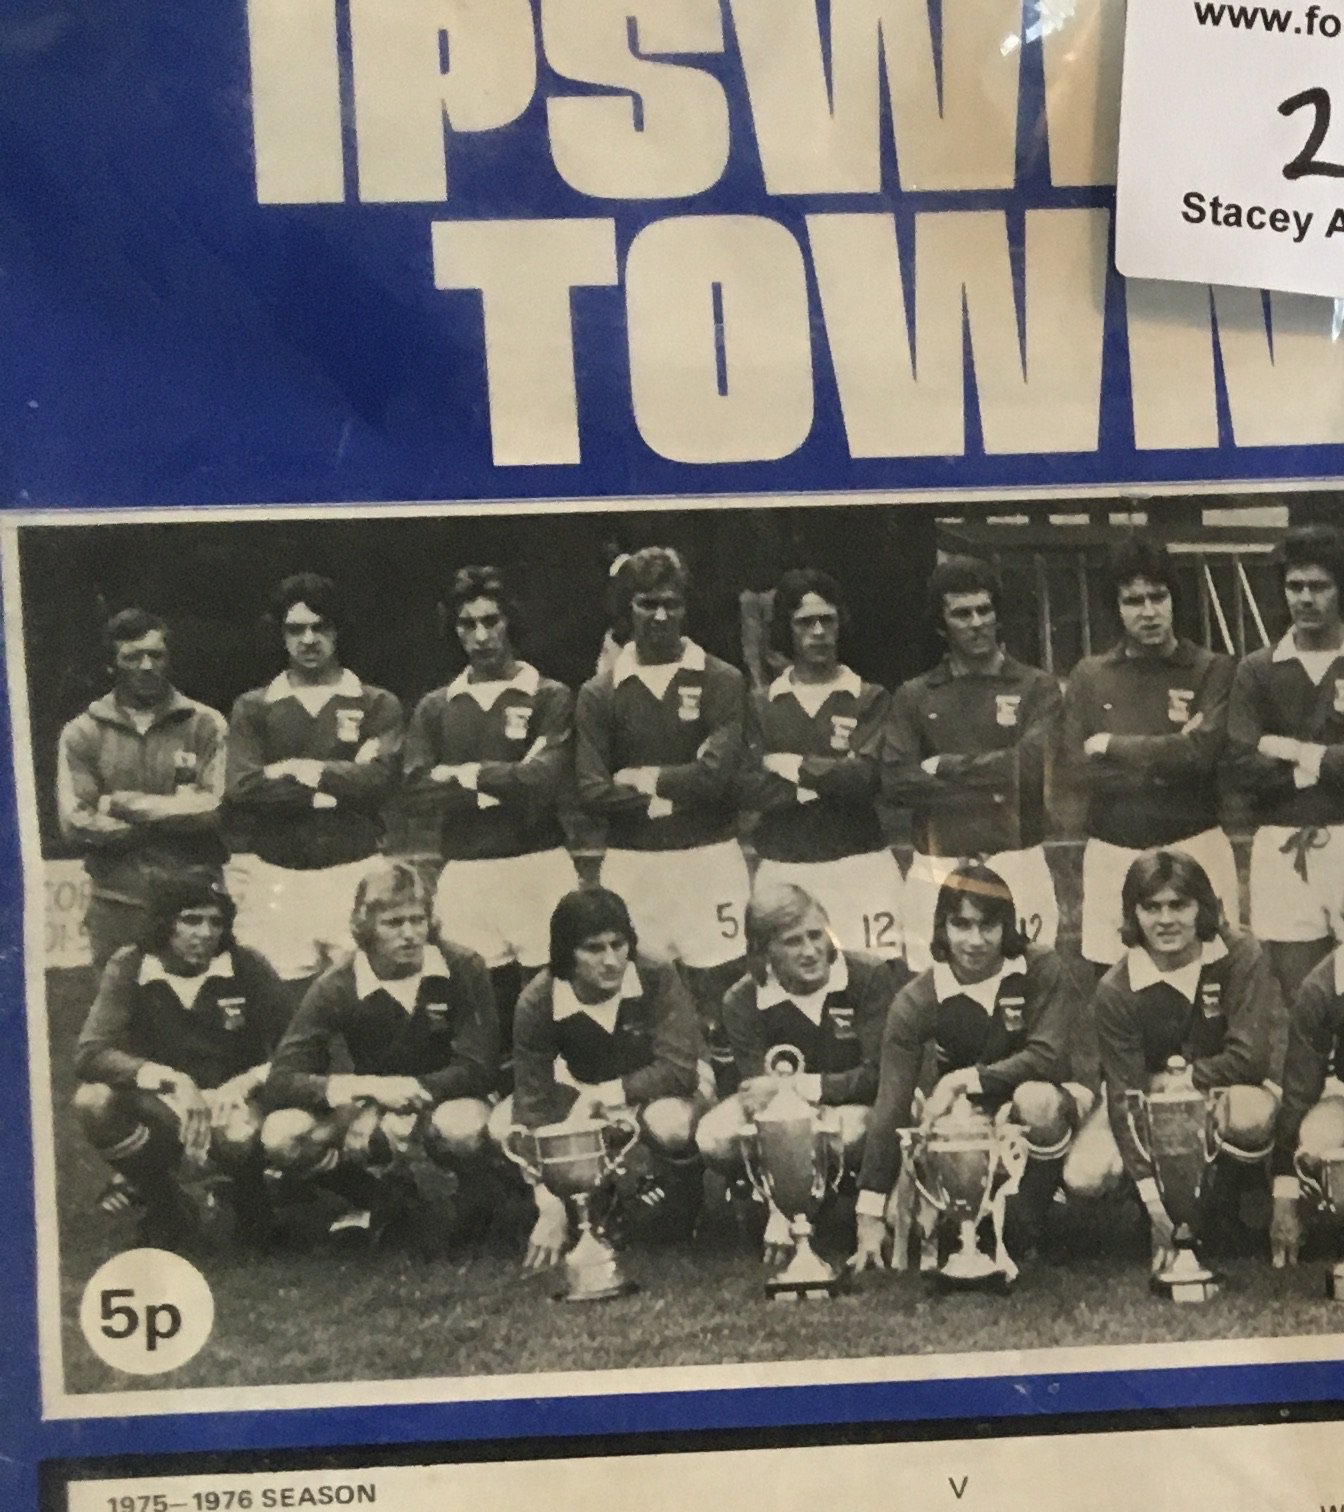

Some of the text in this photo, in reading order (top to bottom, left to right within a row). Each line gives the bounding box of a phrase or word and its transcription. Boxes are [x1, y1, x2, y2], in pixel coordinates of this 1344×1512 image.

[1180, 191, 1314, 241] Stacey
[716, 902, 739, 939] 5
[862, 912, 897, 948] 12
[100, 1288, 183, 1350] 5p
[262, 1483, 377, 1508] SEASON
